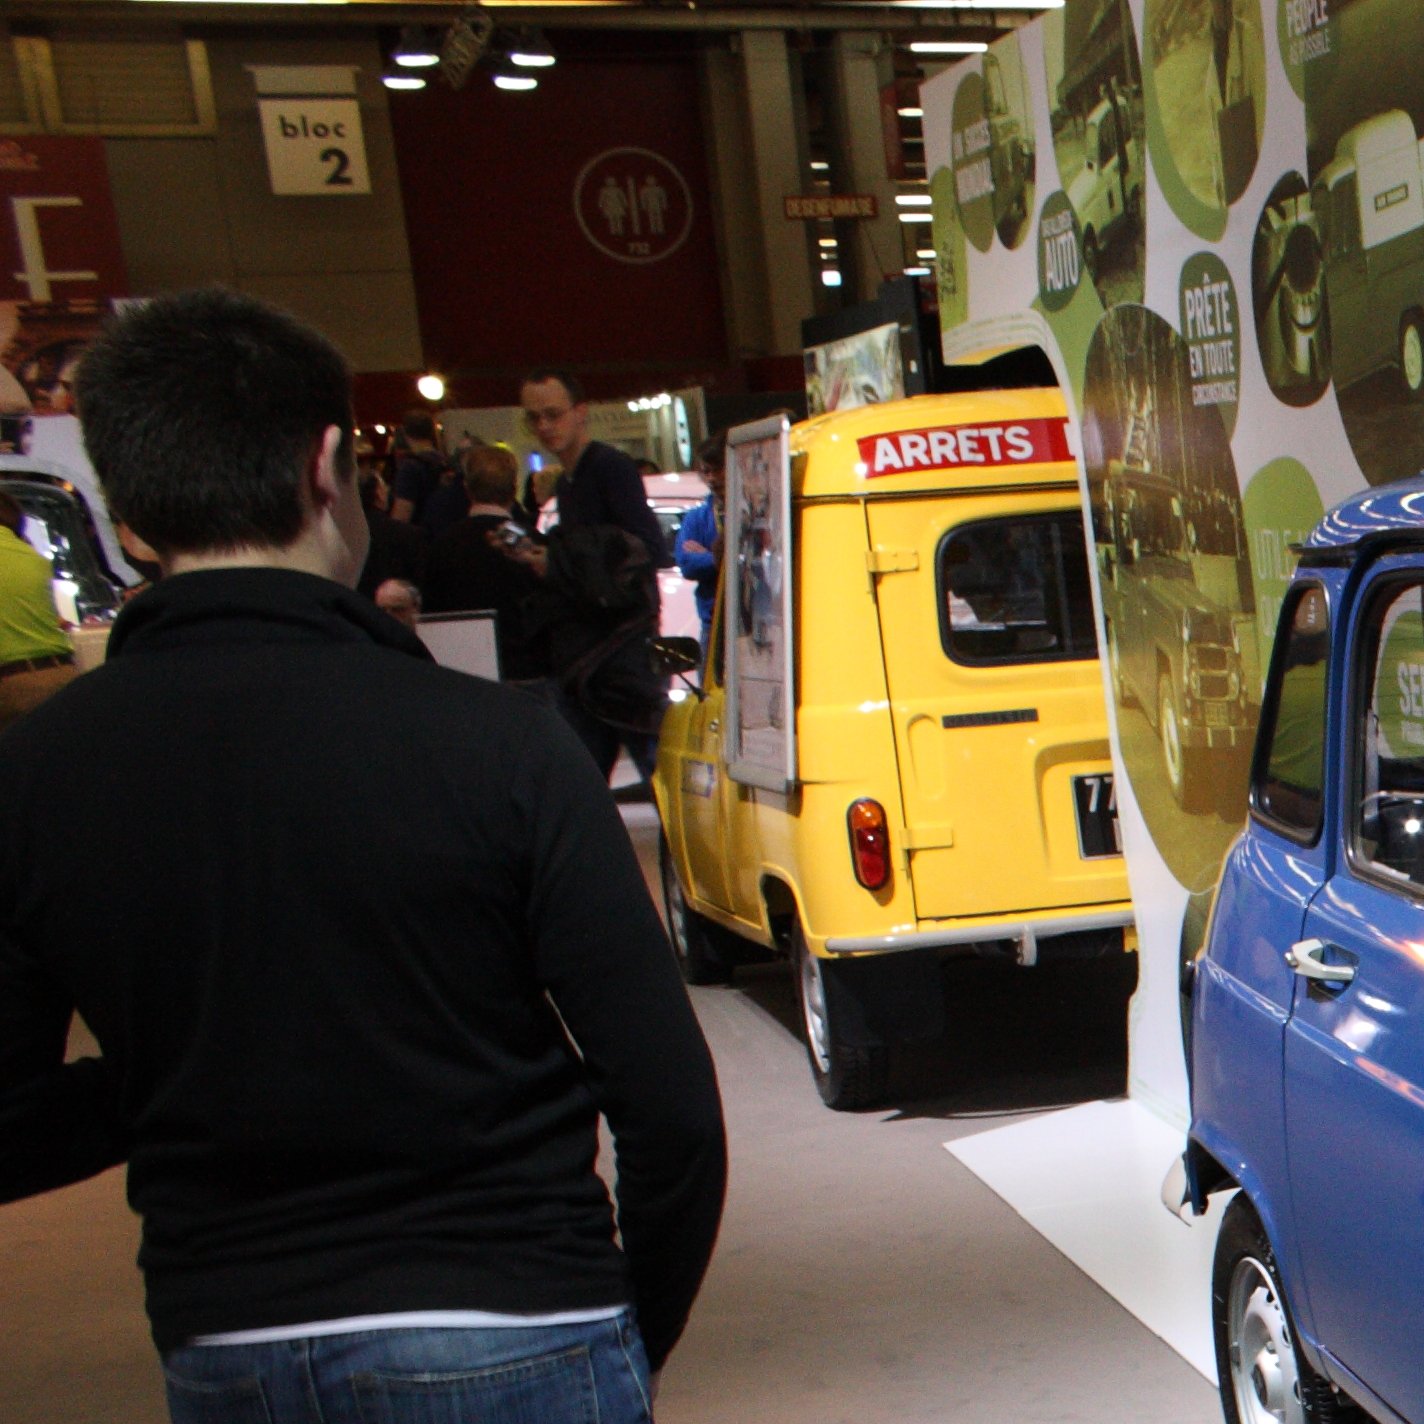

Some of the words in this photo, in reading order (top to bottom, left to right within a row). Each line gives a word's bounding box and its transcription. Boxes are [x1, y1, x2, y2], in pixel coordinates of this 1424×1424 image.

[279, 115, 346, 139] bloc
[320, 148, 354, 186] 2
[1045, 230, 1079, 292] AUTO
[1184, 272, 1233, 340] PRÊTE
[1189, 344, 1204, 379] EN
[1203, 340, 1236, 376] TOUTE
[874, 426, 1034, 472] ARRETS
